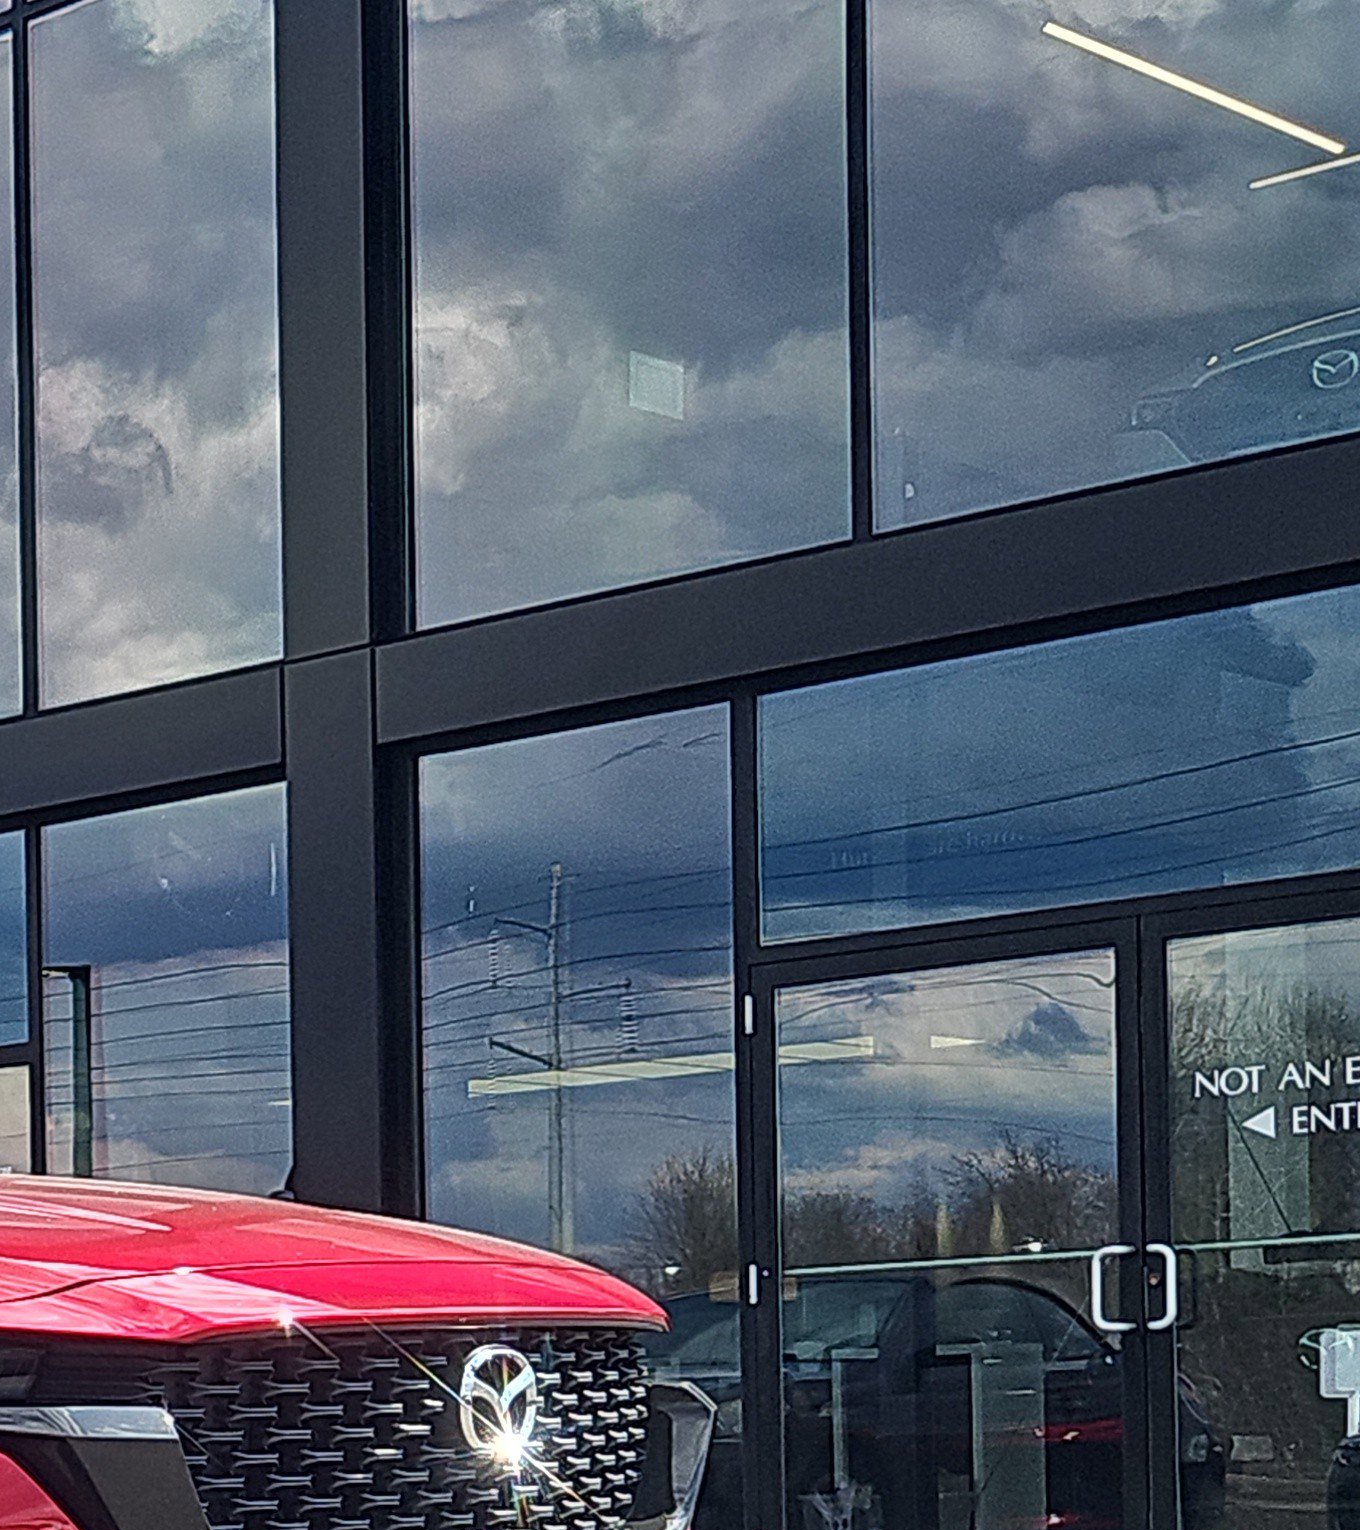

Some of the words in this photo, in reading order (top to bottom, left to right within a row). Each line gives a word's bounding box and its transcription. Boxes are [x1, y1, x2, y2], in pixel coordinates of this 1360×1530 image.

[1194, 1064, 1266, 1098] NOT
[1278, 1059, 1330, 1091] AN
[1292, 1101, 1360, 1135] ENT
